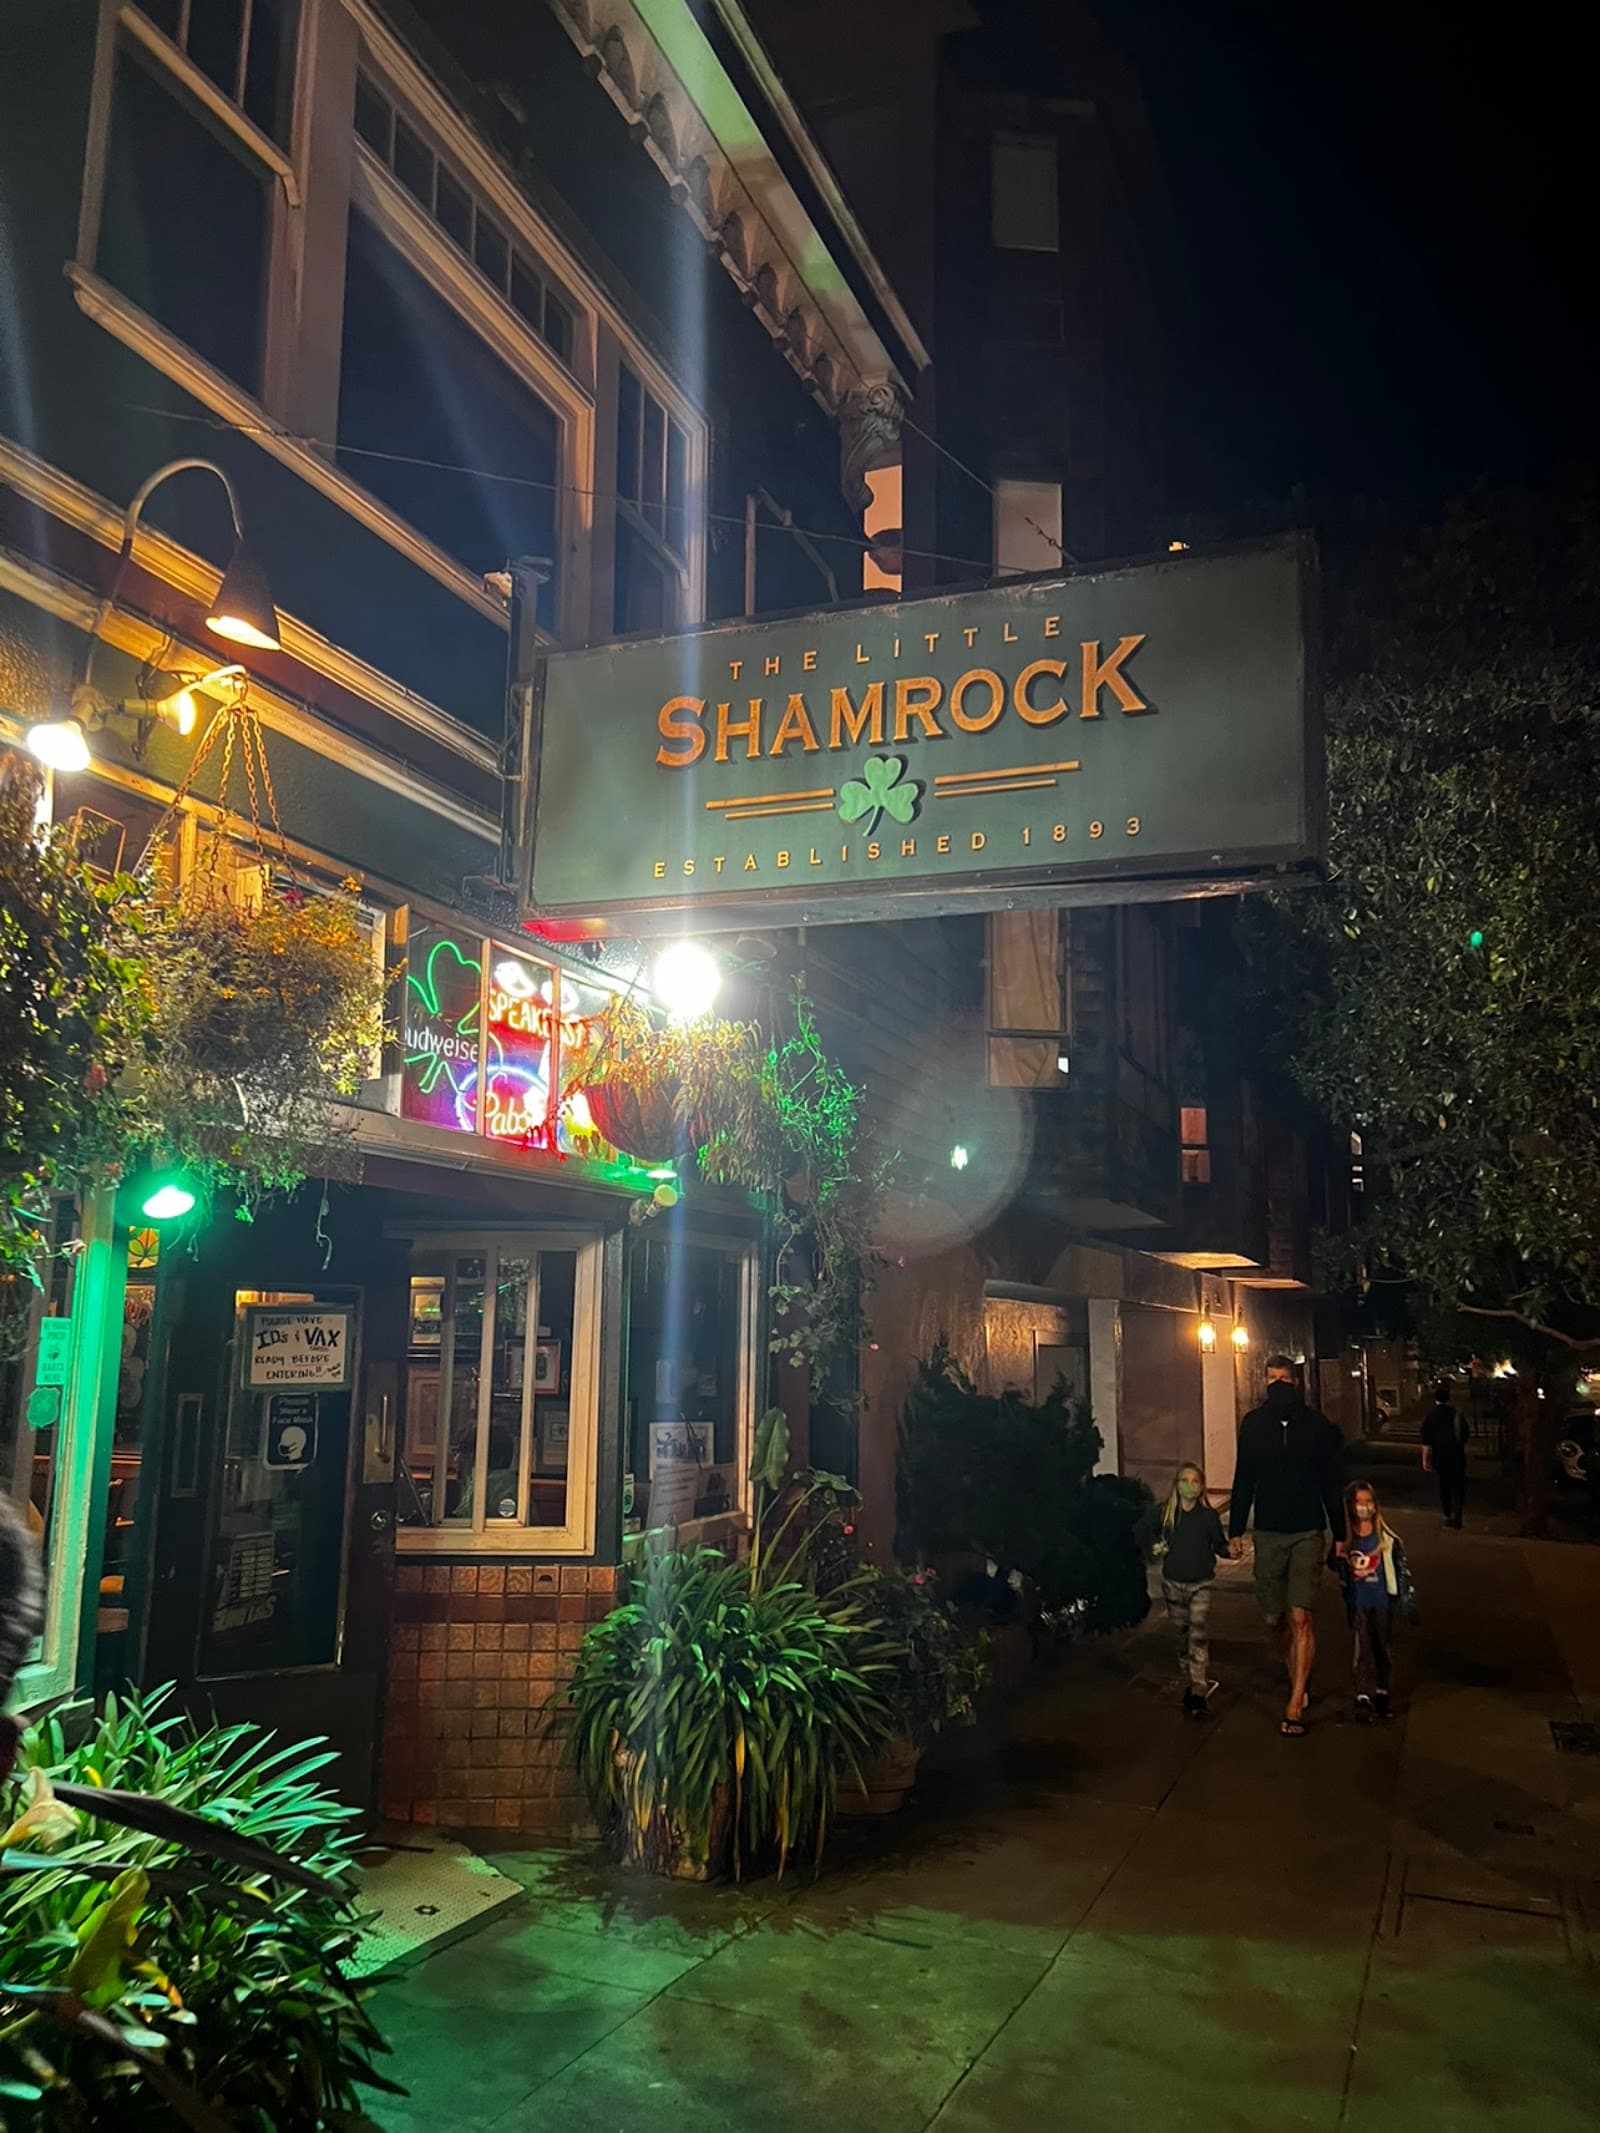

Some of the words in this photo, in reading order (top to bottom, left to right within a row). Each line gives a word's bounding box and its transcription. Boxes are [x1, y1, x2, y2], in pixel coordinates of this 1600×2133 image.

[729, 650, 817, 681] THE
[856, 615, 1060, 664] LITTLE
[655, 634, 1148, 768] SHAMROCK
[653, 832, 987, 878] ESTABLISHED
[1022, 817, 1141, 846] 1893
[255, 1354, 285, 1366] READY
[292, 1354, 329, 1363] BEFORE
[304, 1326, 340, 1347] VAX
